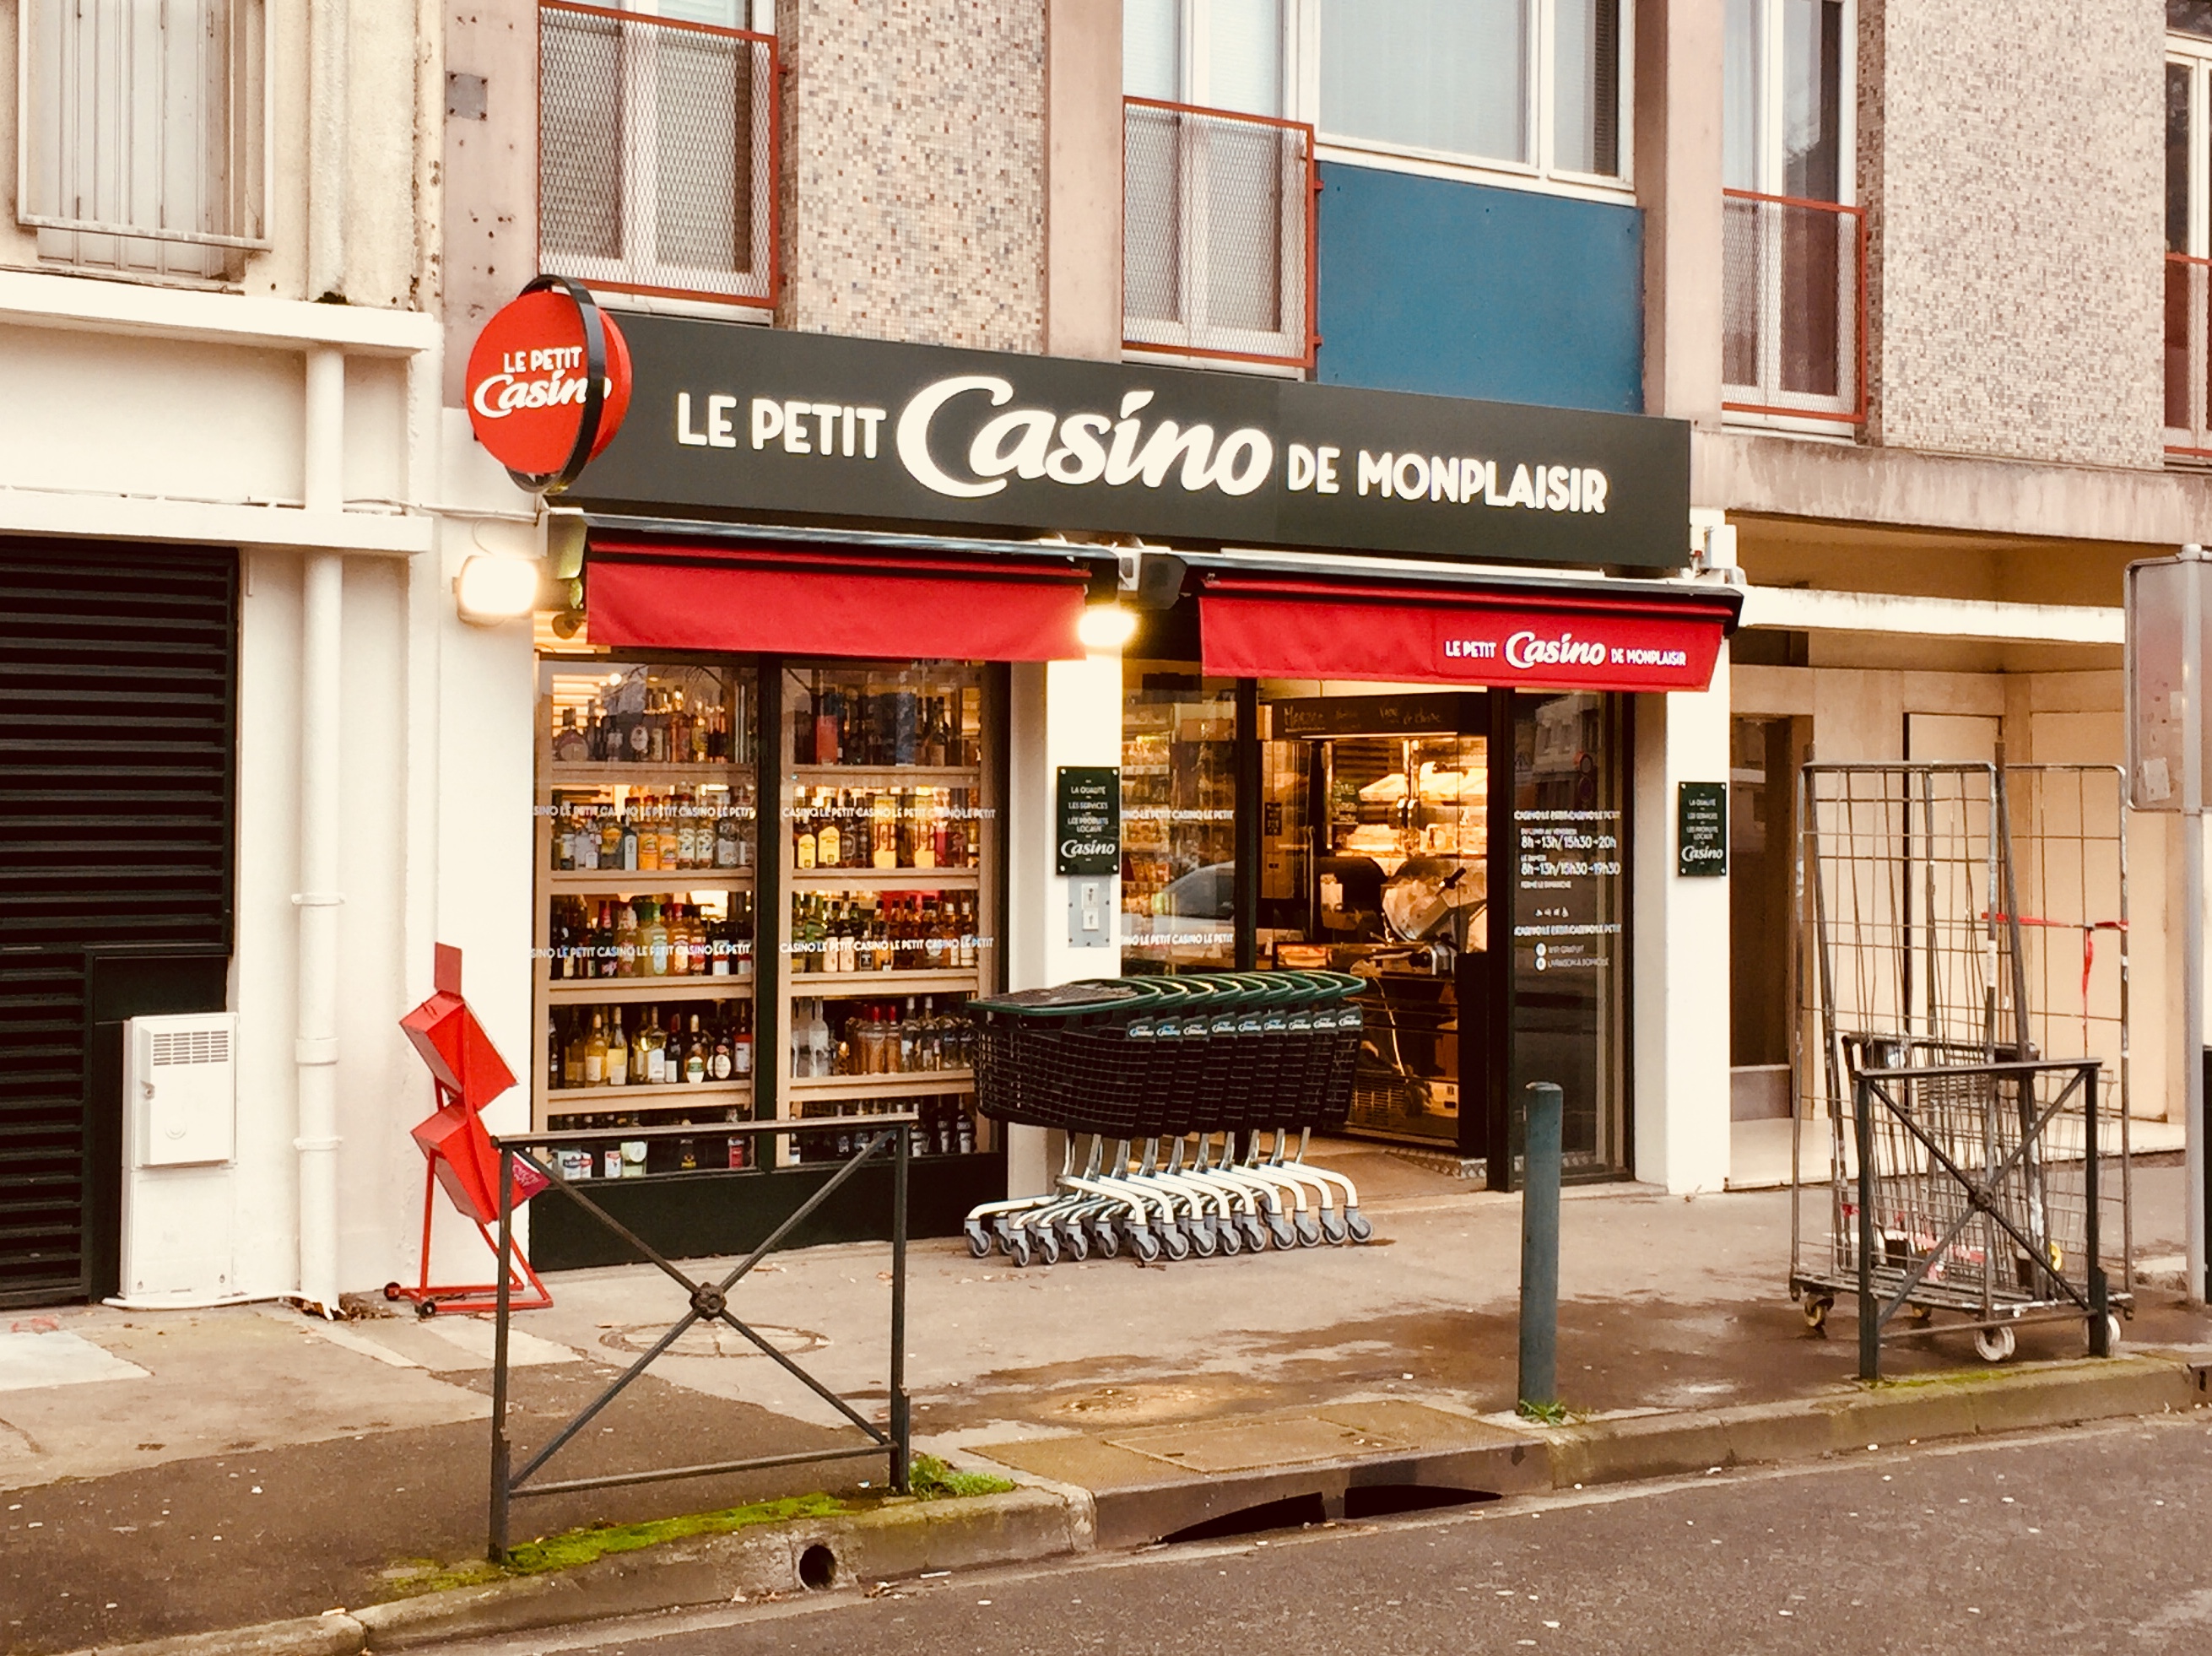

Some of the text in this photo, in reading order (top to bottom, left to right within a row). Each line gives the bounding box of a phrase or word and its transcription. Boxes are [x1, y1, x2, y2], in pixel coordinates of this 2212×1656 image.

[504, 346, 582, 373] LE PETIT
[678, 376, 1608, 513] LE PETIT Casino DE MONPLAISIR
[1446, 631, 1686, 668] LE PETIT Casino DE MONPLAISIR
[1060, 839, 1116, 858] Casino
[1681, 845, 1723, 862] Casino
[854, 940, 889, 951] CASINO
[901, 939, 923, 950] PETIT
